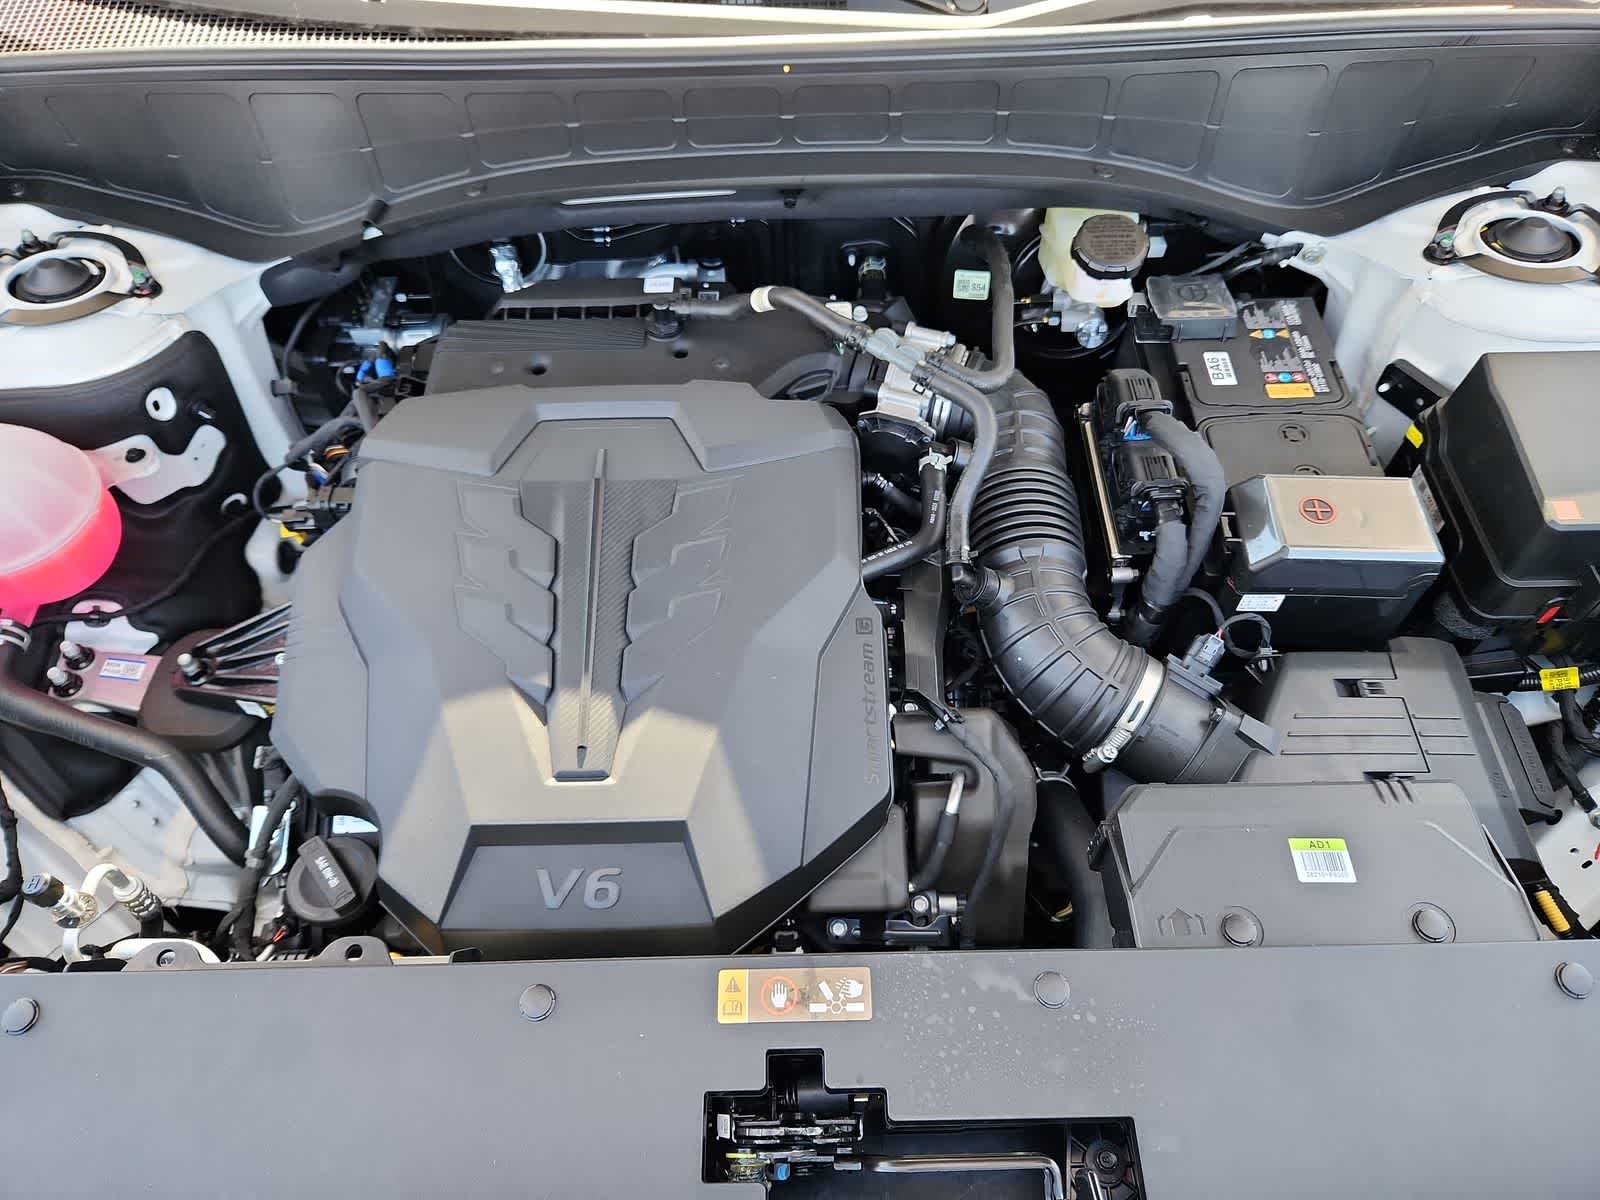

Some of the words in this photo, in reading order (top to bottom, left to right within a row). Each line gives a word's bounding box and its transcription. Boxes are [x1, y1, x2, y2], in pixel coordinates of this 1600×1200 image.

[1207, 357, 1225, 380] BA6
[862, 643, 880, 785] Smartstream
[1309, 840, 1331, 848] AD1
[536, 866, 622, 909] V6
